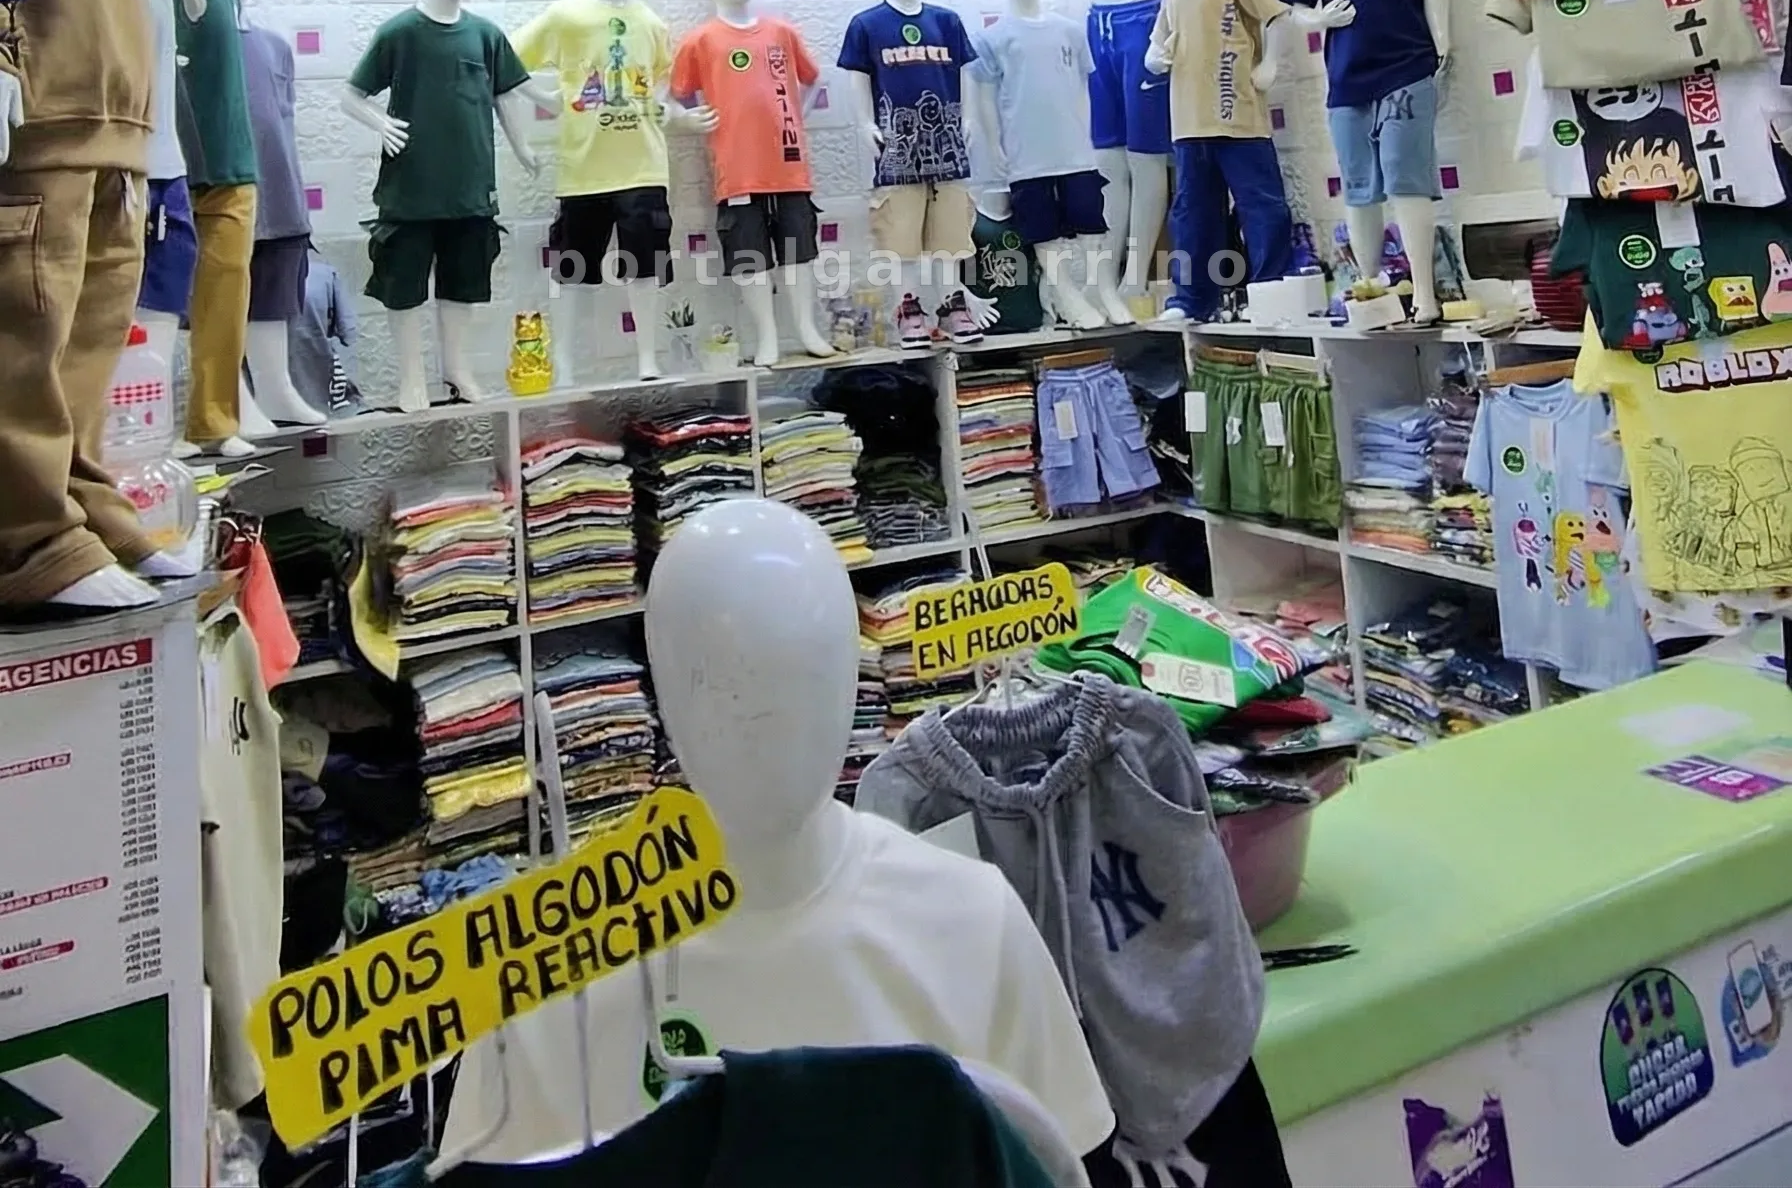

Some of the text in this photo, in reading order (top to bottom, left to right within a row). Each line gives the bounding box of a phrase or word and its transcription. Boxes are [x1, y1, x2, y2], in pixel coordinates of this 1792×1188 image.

[1655, 346, 1792, 392] ROBLOX
[918, 634, 956, 671] EN
[465, 805, 699, 969] ALGODÓN
[319, 998, 465, 1114] PIMA
